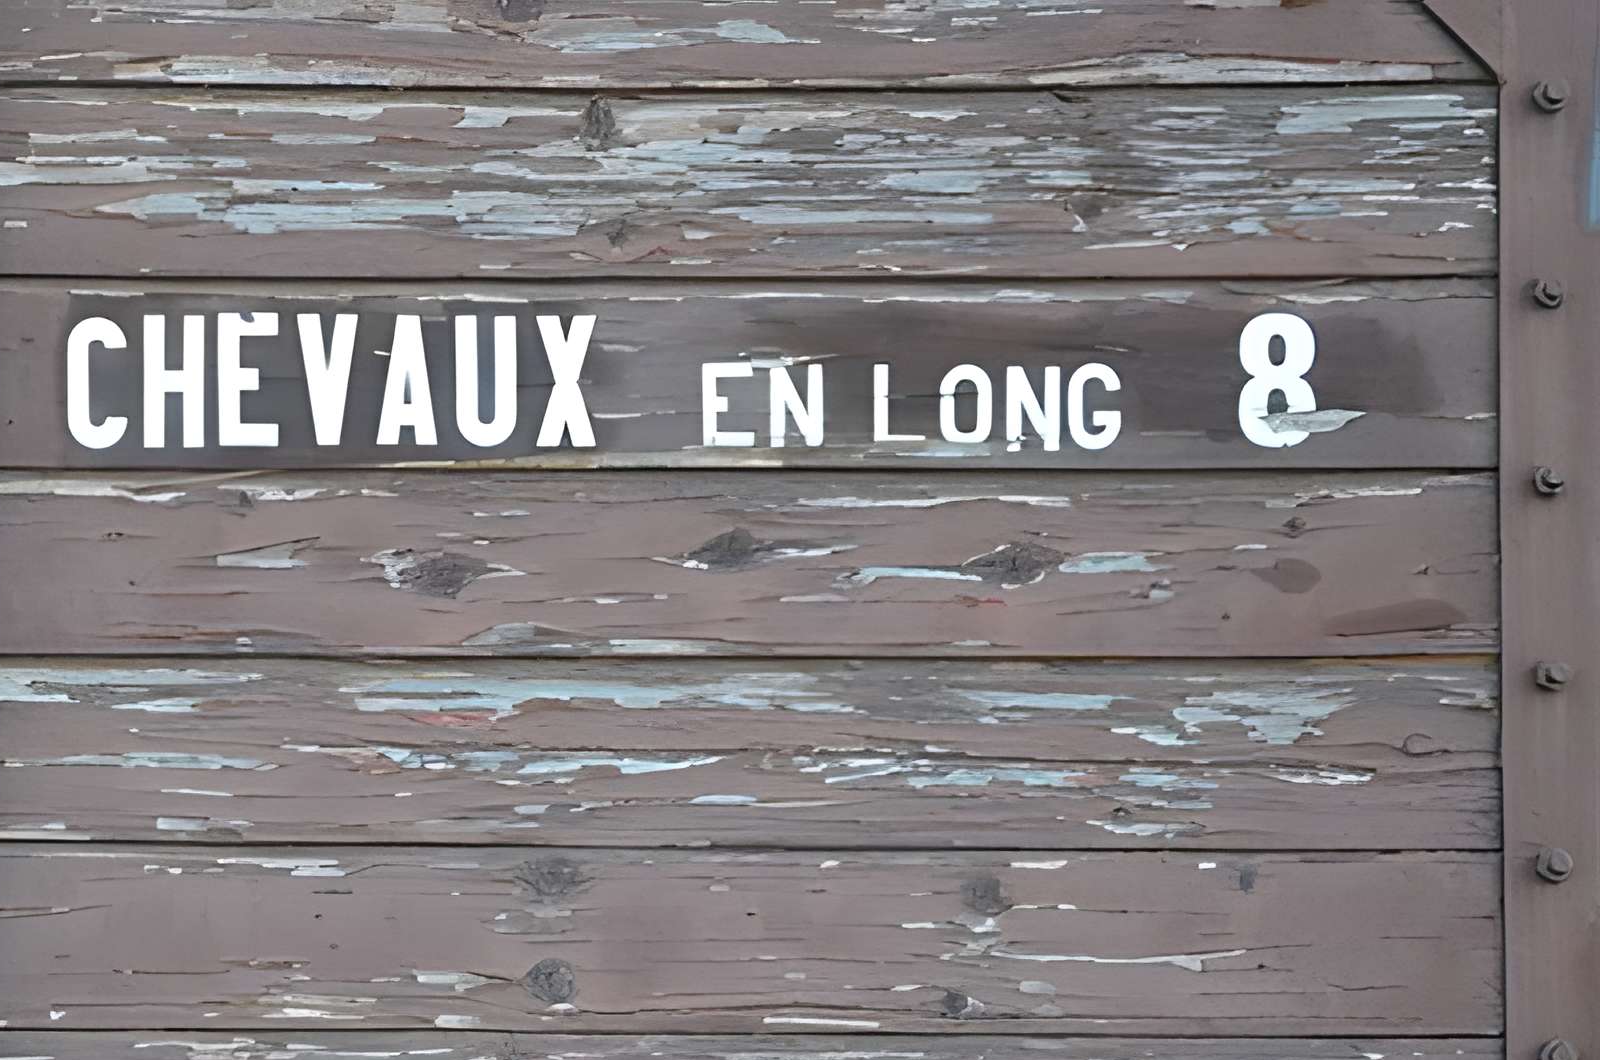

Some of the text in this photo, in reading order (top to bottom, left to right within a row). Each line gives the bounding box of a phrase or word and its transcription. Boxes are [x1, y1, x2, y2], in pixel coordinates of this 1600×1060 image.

[67, 312, 1318, 451] CHEVAUX EN LONG 8
